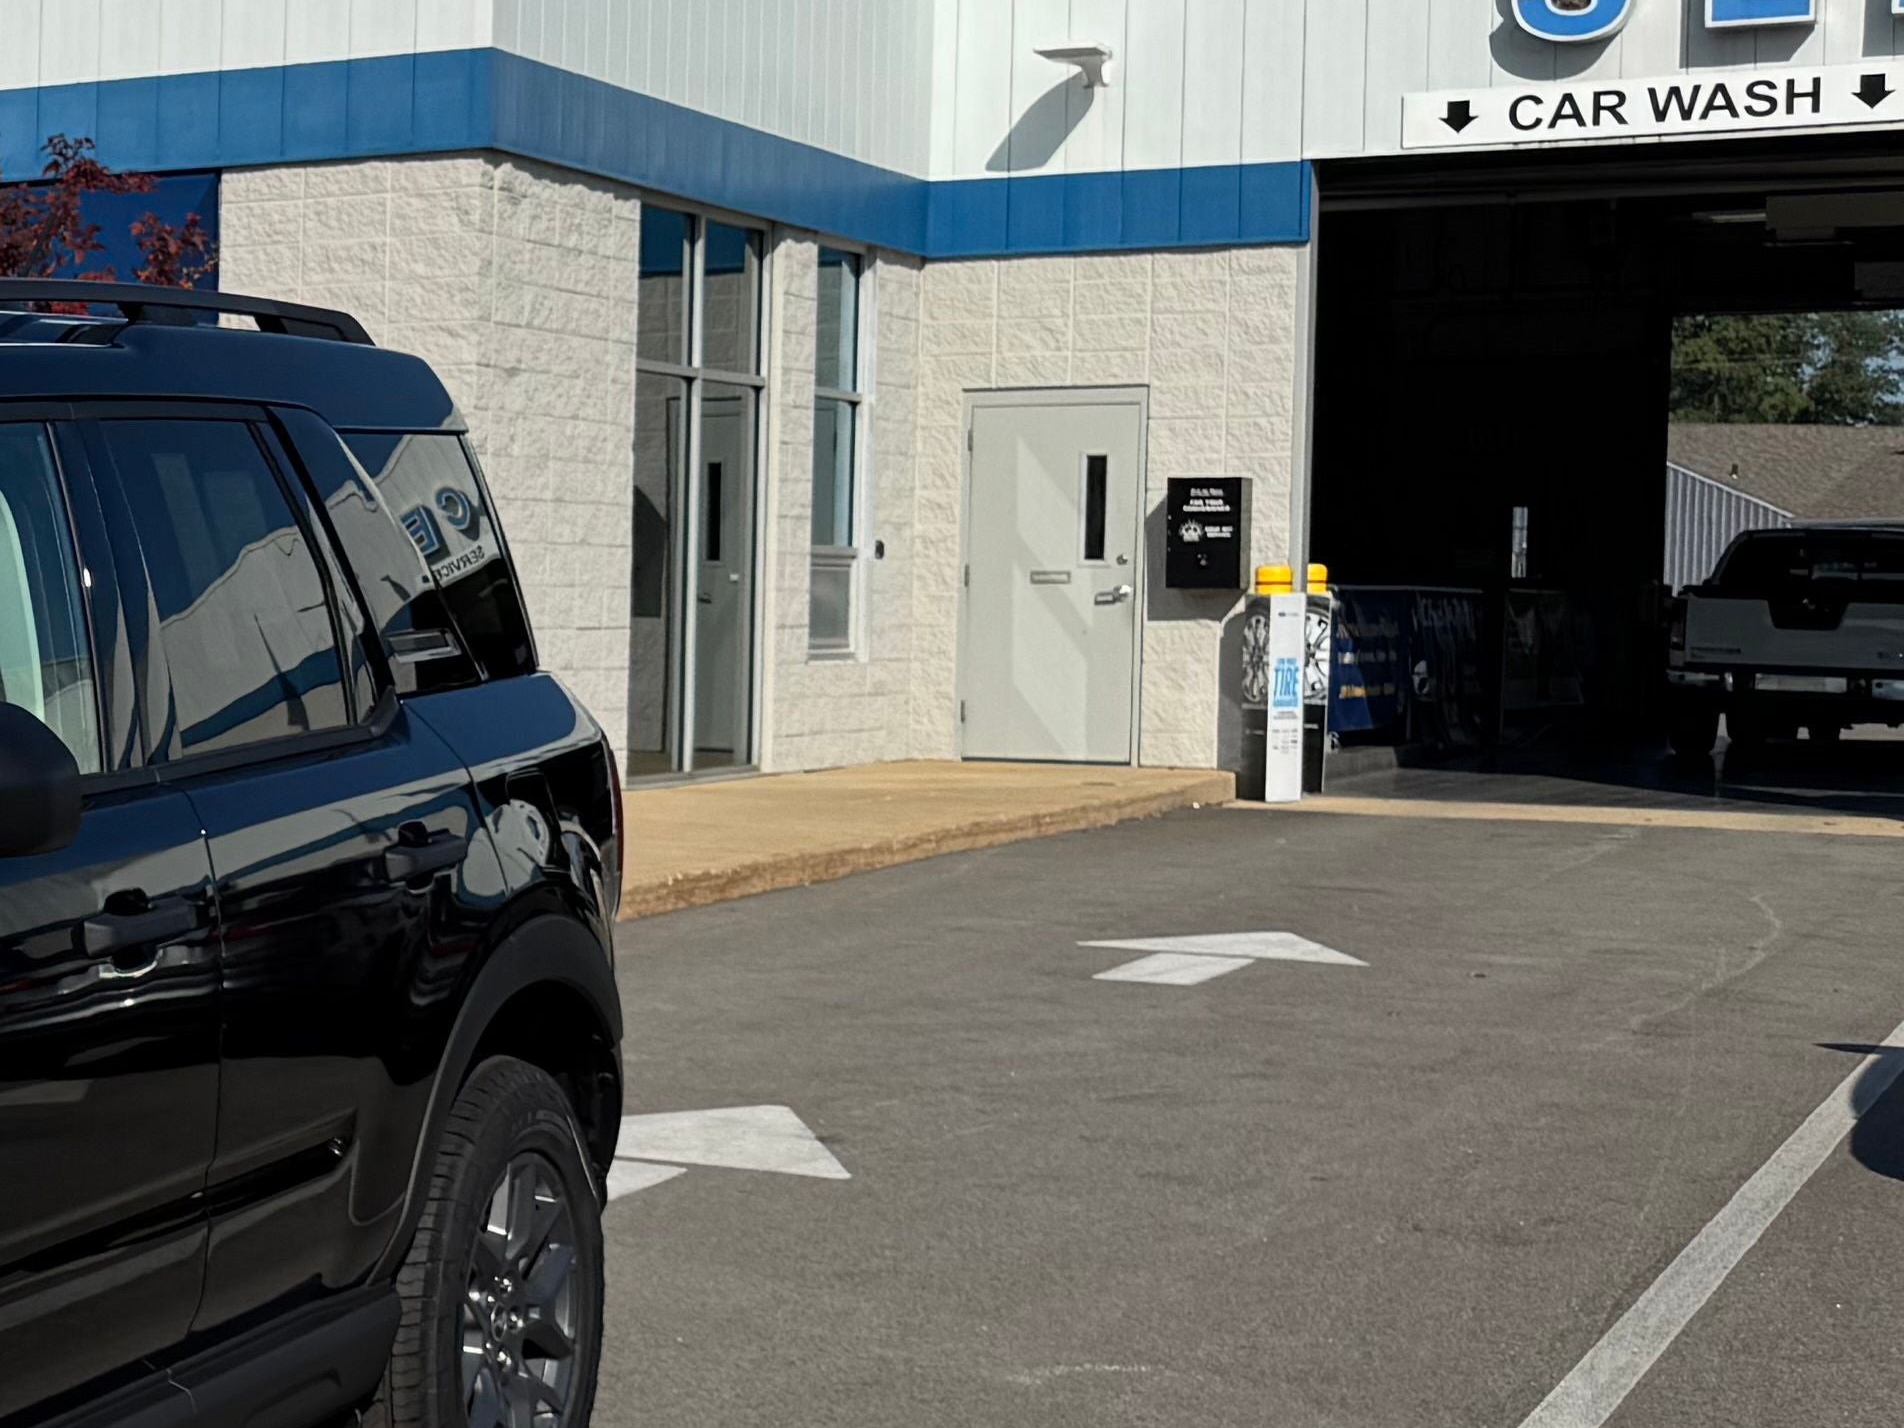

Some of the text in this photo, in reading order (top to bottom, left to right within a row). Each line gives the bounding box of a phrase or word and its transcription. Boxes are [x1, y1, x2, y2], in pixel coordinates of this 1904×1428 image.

[1508, 76, 1821, 131] CAR WASH
[1274, 667, 1299, 697] TIRE
